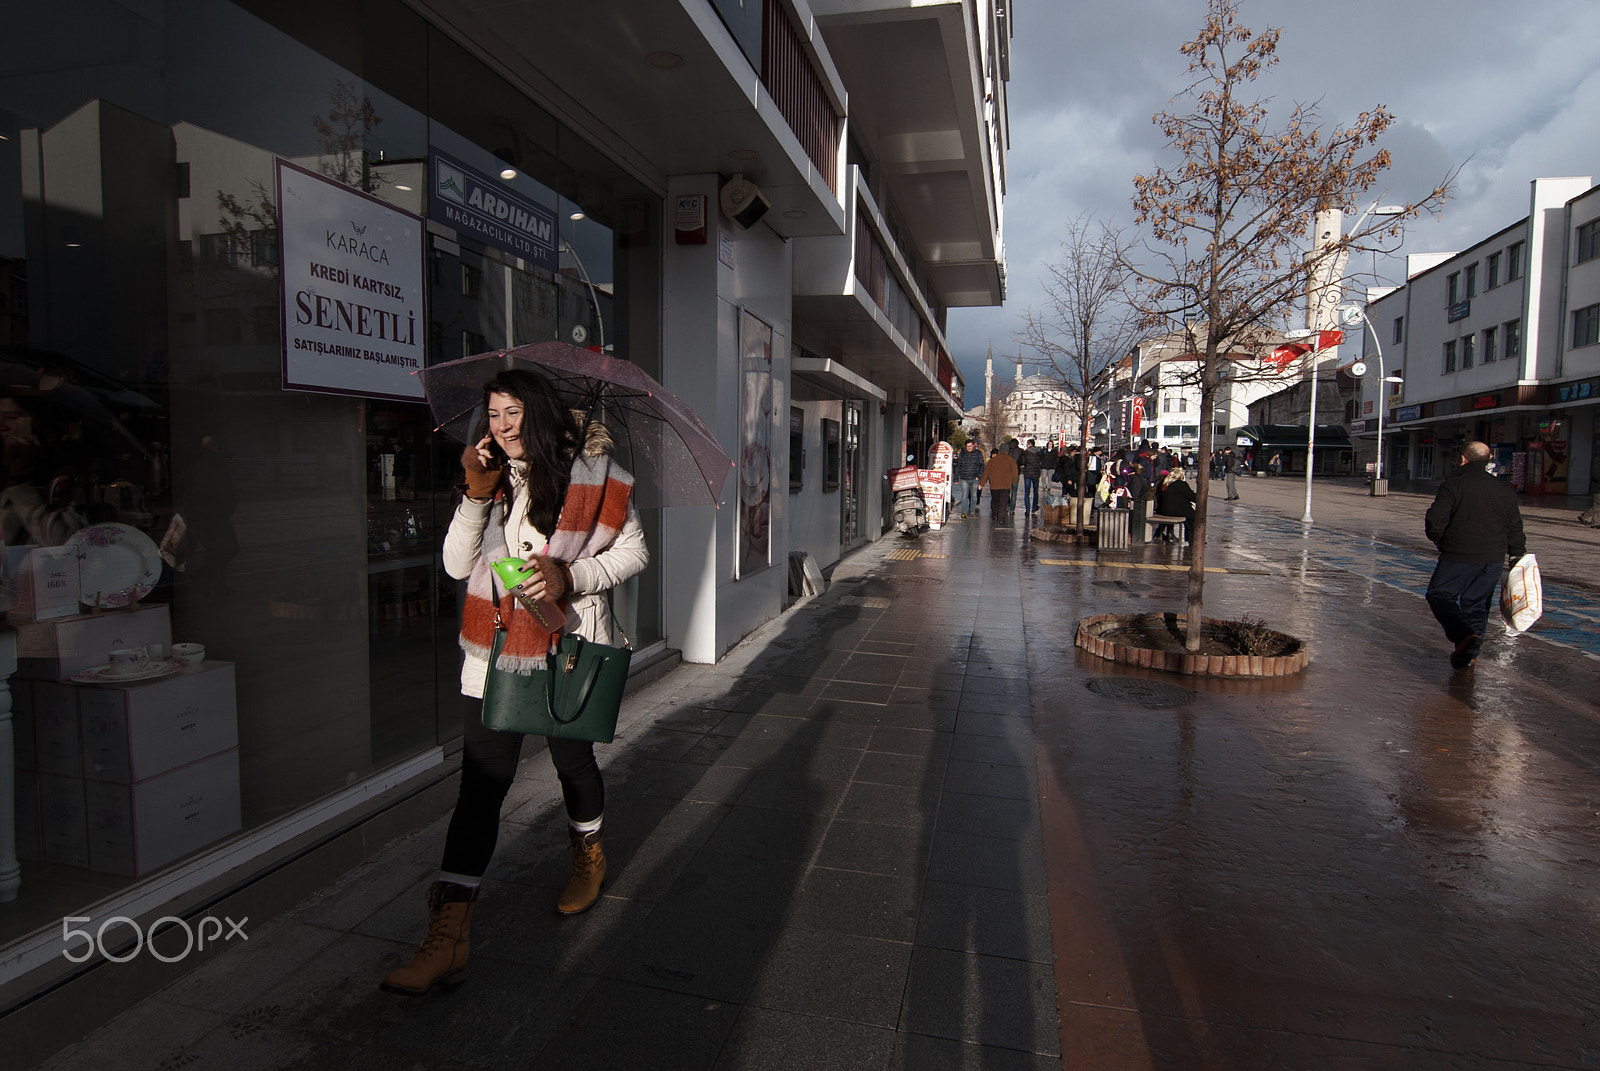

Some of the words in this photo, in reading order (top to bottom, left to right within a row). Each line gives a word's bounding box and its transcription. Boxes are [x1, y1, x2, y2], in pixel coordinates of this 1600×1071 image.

[446, 206, 513, 246] MAĞAZACILIK
[468, 186, 551, 241] ARDIHAN
[326, 229, 390, 266] KARACA
[310, 261, 349, 286] KREDİ
[352, 273, 404, 304] KARTSIZ,
[296, 290, 416, 346] SENETLİ
[294, 337, 362, 360] SATIŞLARIMIZ
[363, 349, 420, 369] BAŞLAMIŞTIR.
